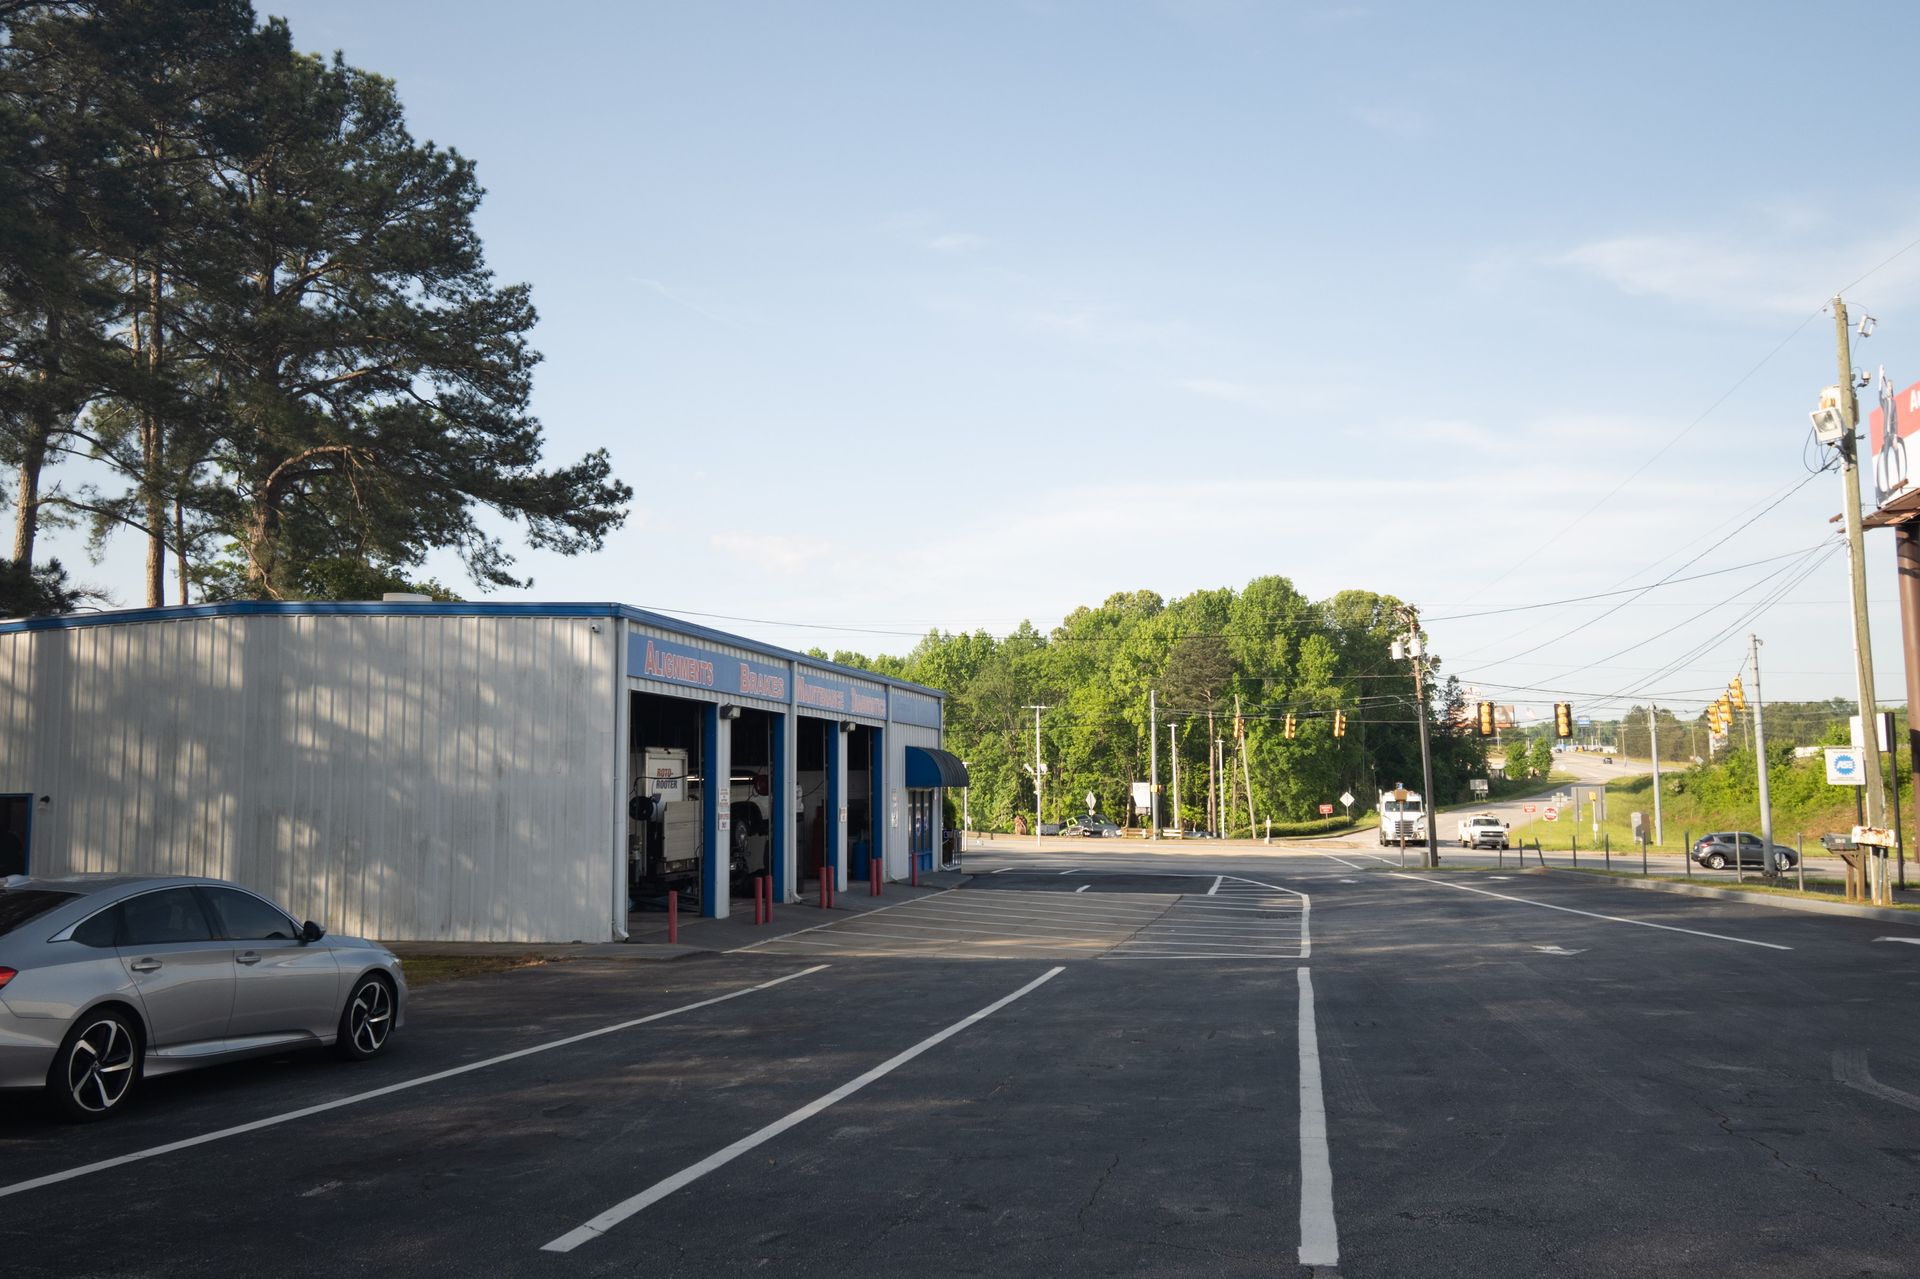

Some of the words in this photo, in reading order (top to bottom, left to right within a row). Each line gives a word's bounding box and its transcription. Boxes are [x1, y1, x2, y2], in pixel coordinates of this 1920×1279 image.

[644, 640, 714, 688] ALIGNMENTS
[739, 663, 785, 699] BRAKES
[656, 780, 678, 790] ROOTER
